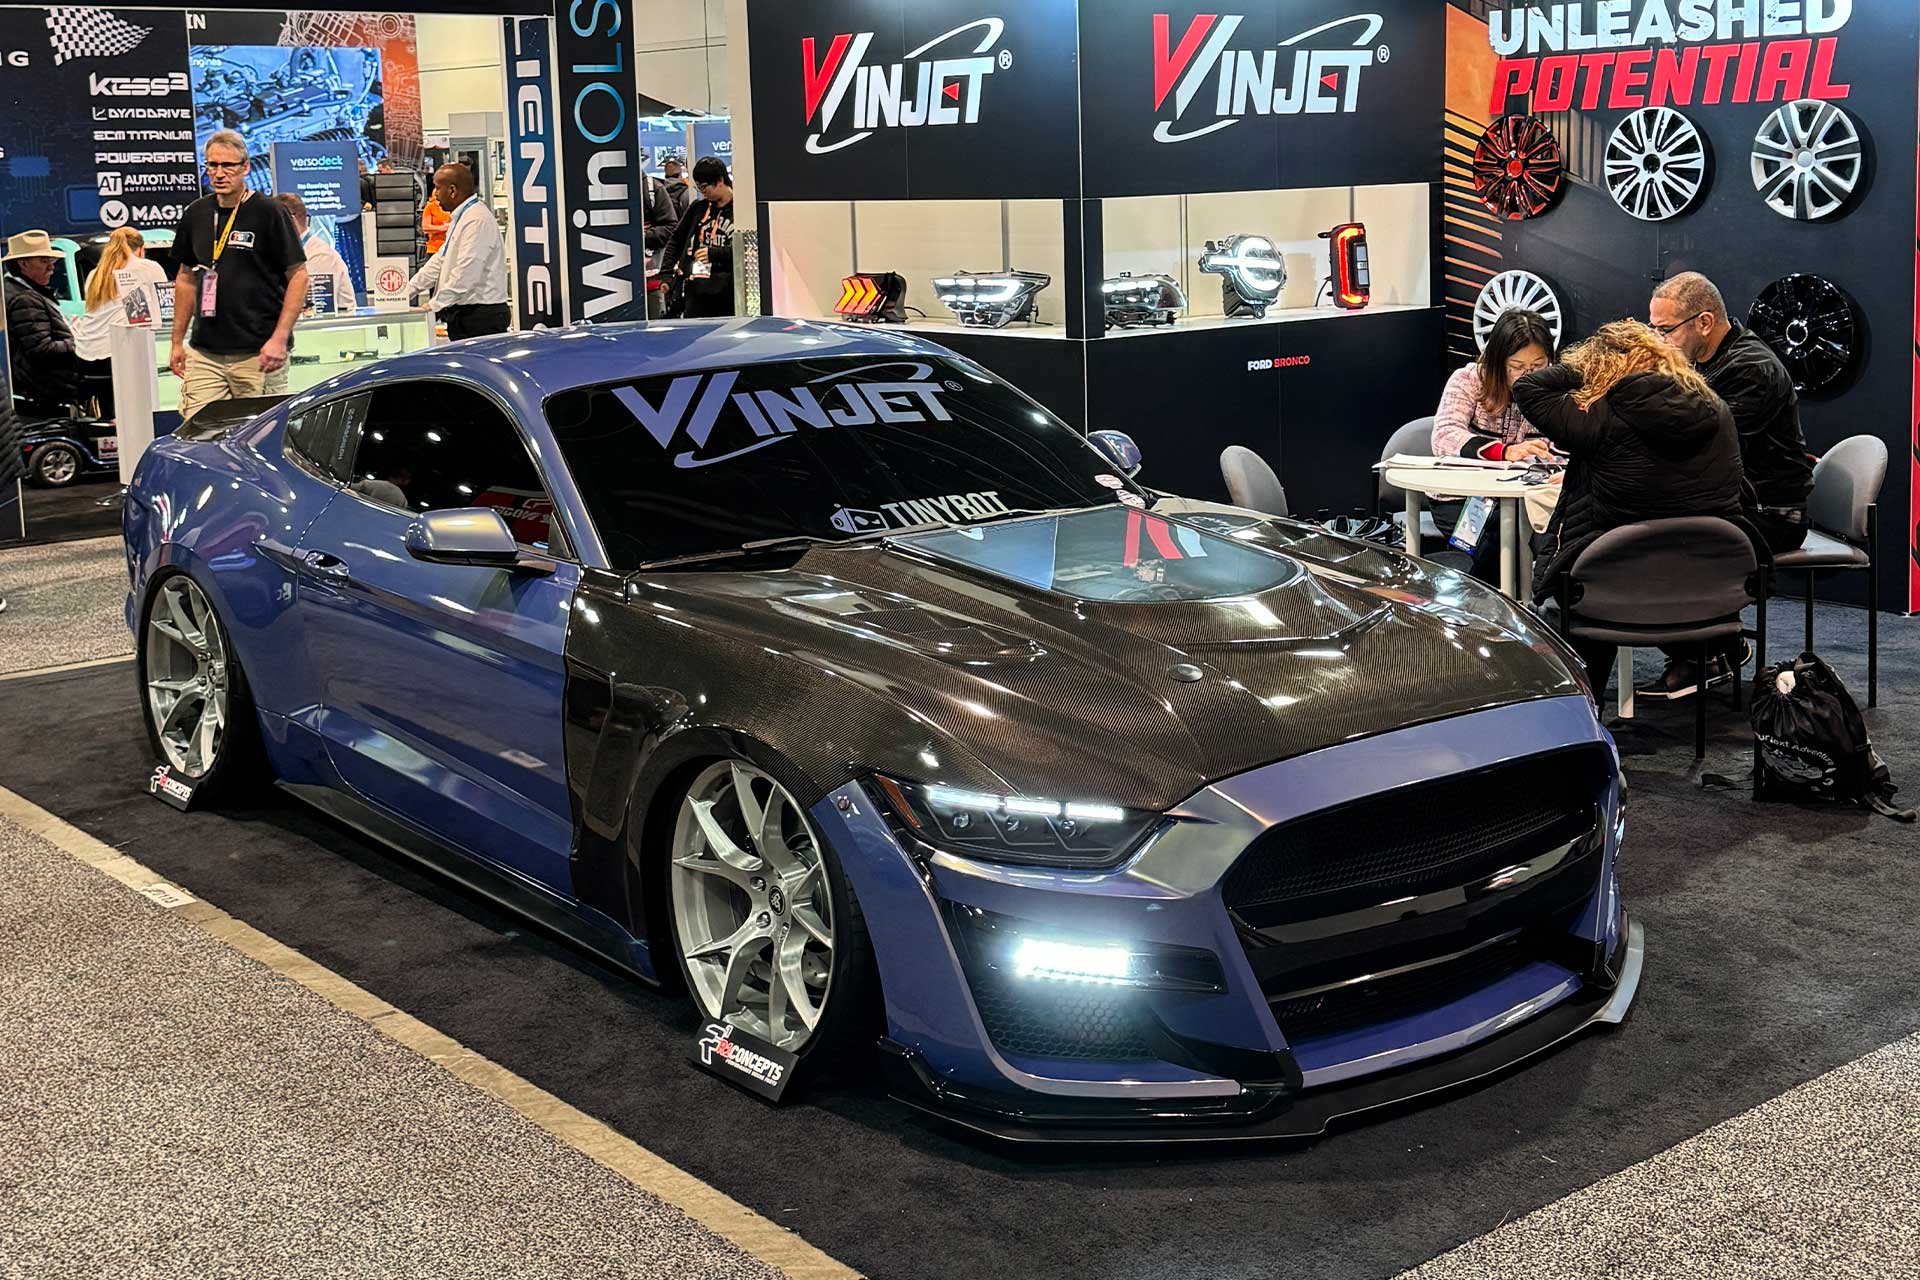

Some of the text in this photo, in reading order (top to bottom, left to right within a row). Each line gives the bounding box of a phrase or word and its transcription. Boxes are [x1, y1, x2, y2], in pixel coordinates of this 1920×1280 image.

[1489, 0, 1852, 55] UNLEASHED
[802, 32, 995, 133] VINJET
[1153, 14, 1374, 120] VINJET
[1489, 37, 1851, 114] POTENTIAL
[93, 130, 192, 140] ECM TITANIUM
[95, 152, 195, 164] POWERGATE
[125, 174, 196, 185] AUTOTUNER
[290, 155, 343, 168] versodeck
[515, 17, 552, 330] LIENTE
[569, 0, 633, 318] WinOLS
[1247, 355, 1310, 371] FORD BRONCO
[880, 491, 1009, 528] TINYBOT
